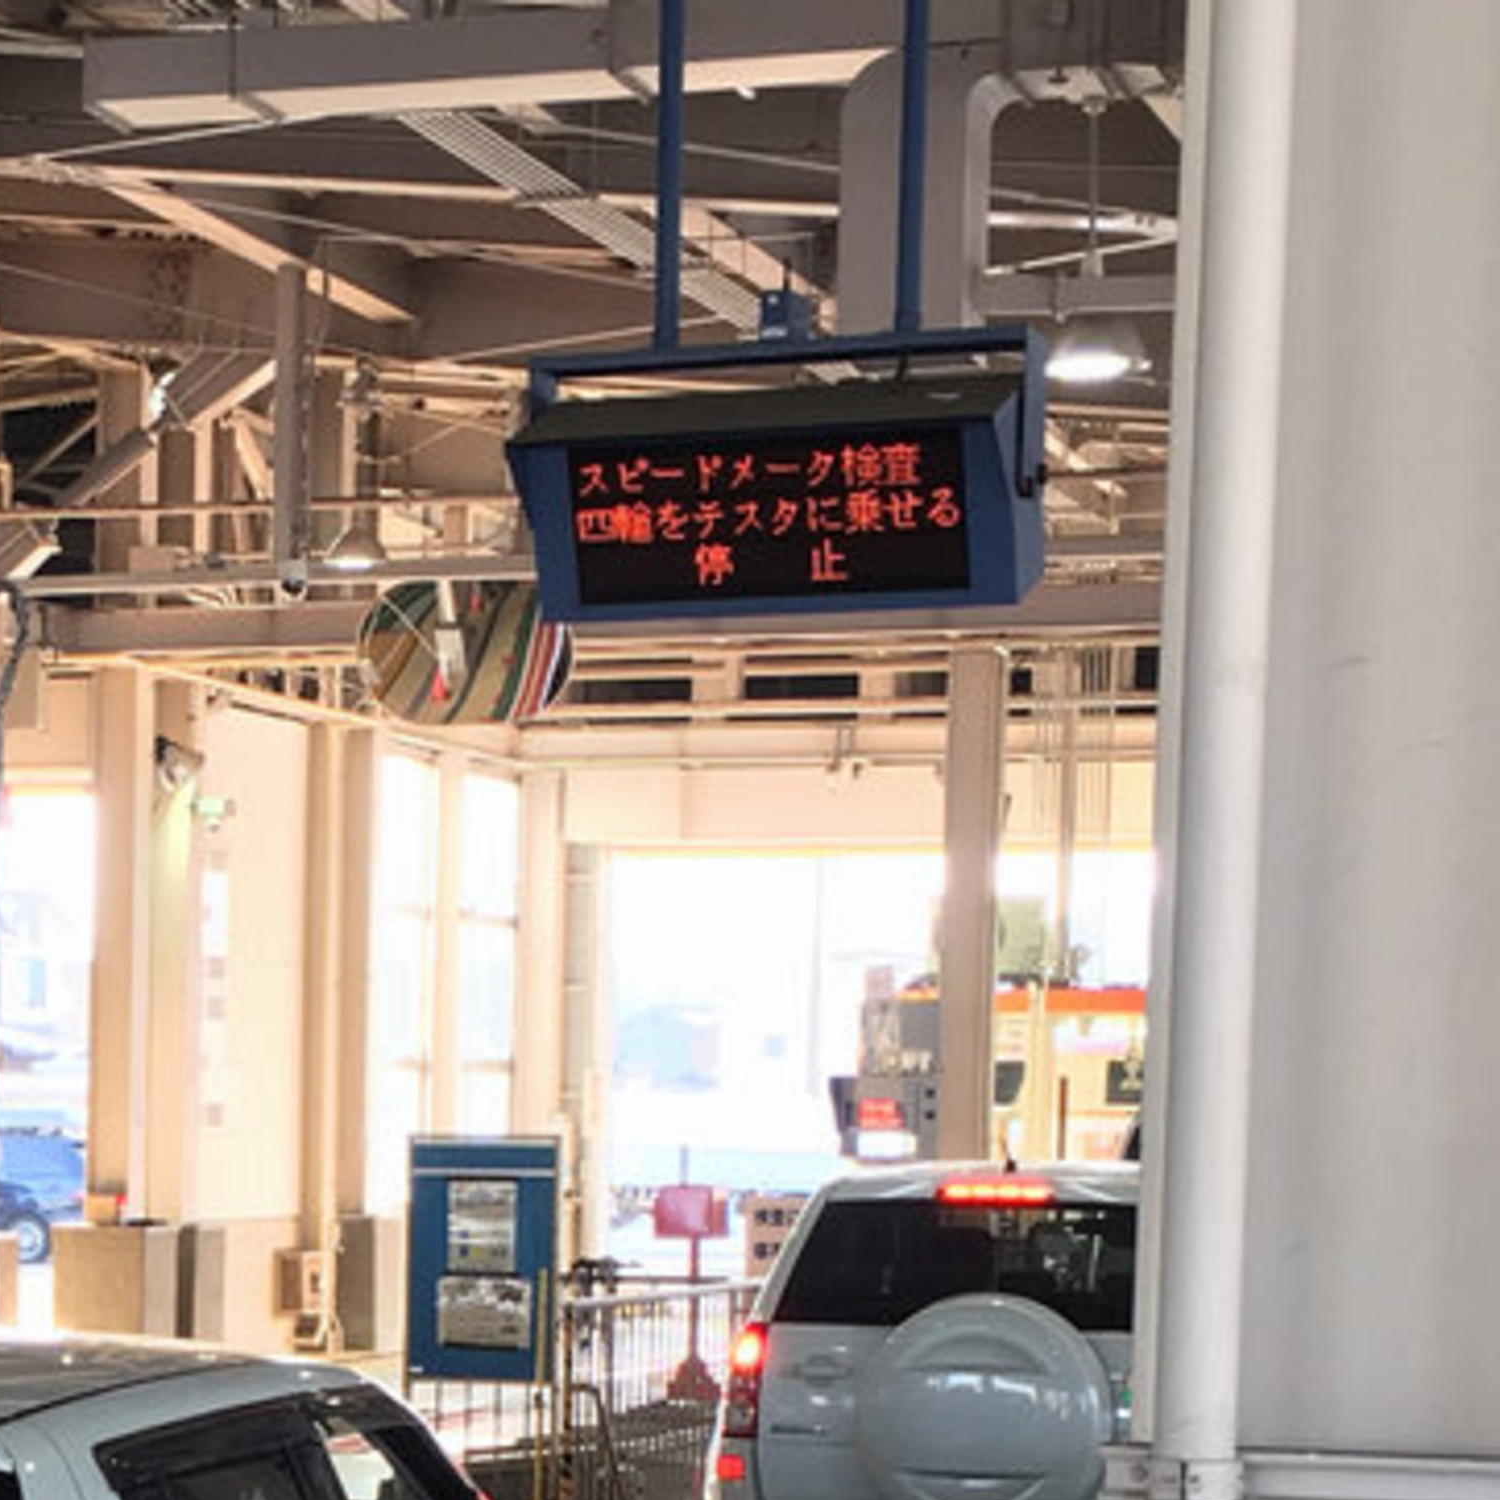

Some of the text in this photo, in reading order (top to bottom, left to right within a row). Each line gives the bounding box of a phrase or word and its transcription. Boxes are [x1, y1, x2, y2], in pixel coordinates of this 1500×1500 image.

[575, 488, 961, 544] 四輪をテスタに乗せる
